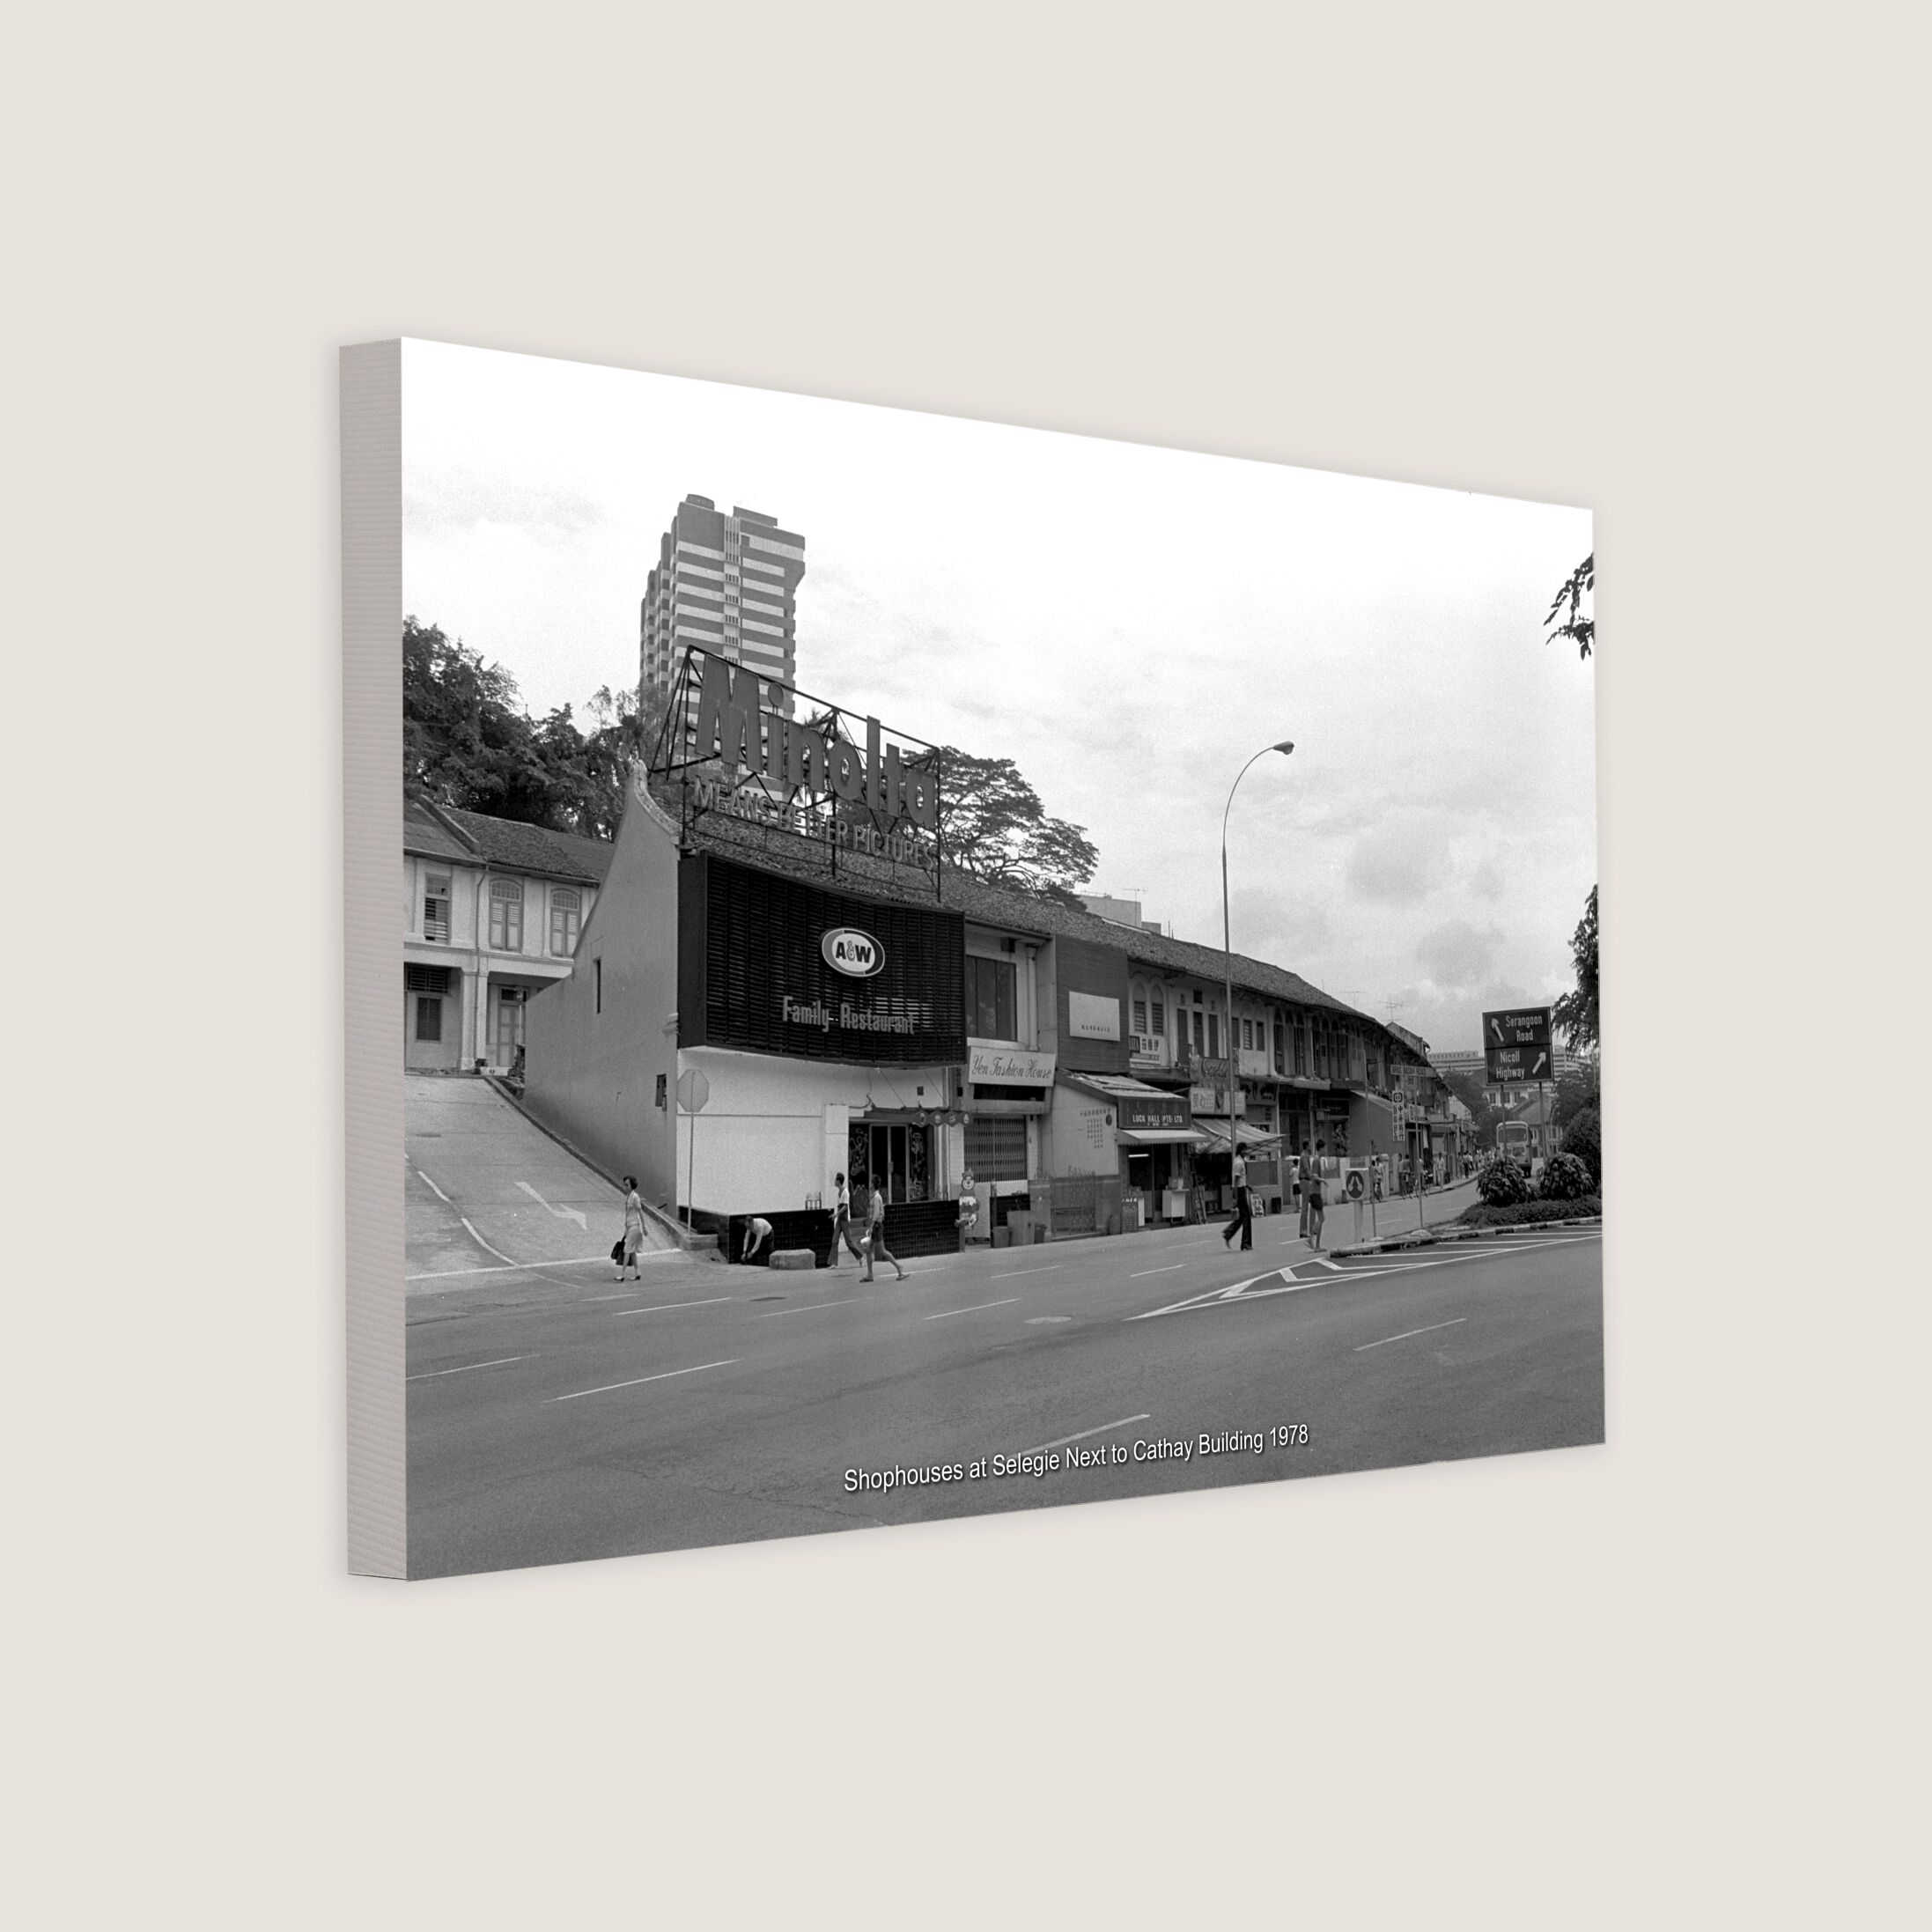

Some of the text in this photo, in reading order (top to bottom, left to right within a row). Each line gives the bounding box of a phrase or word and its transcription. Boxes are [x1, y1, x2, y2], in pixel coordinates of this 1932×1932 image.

[695, 654, 937, 830] Minolta
[694, 776, 771, 825] MEANS
[853, 825, 933, 870] PICTURES
[836, 940, 872, 964] A&W
[782, 995, 915, 1035] Family Restaurant
[1505, 1014, 1543, 1029] Serangoon
[1515, 1029, 1534, 1043] Road
[1500, 1050, 1521, 1064] Nicoll
[990, 1057, 1024, 1077] Fashion
[1025, 1058, 1052, 1079] House
[1496, 1066, 1525, 1081] Highway
[1132, 1114, 1146, 1124] LUCK
